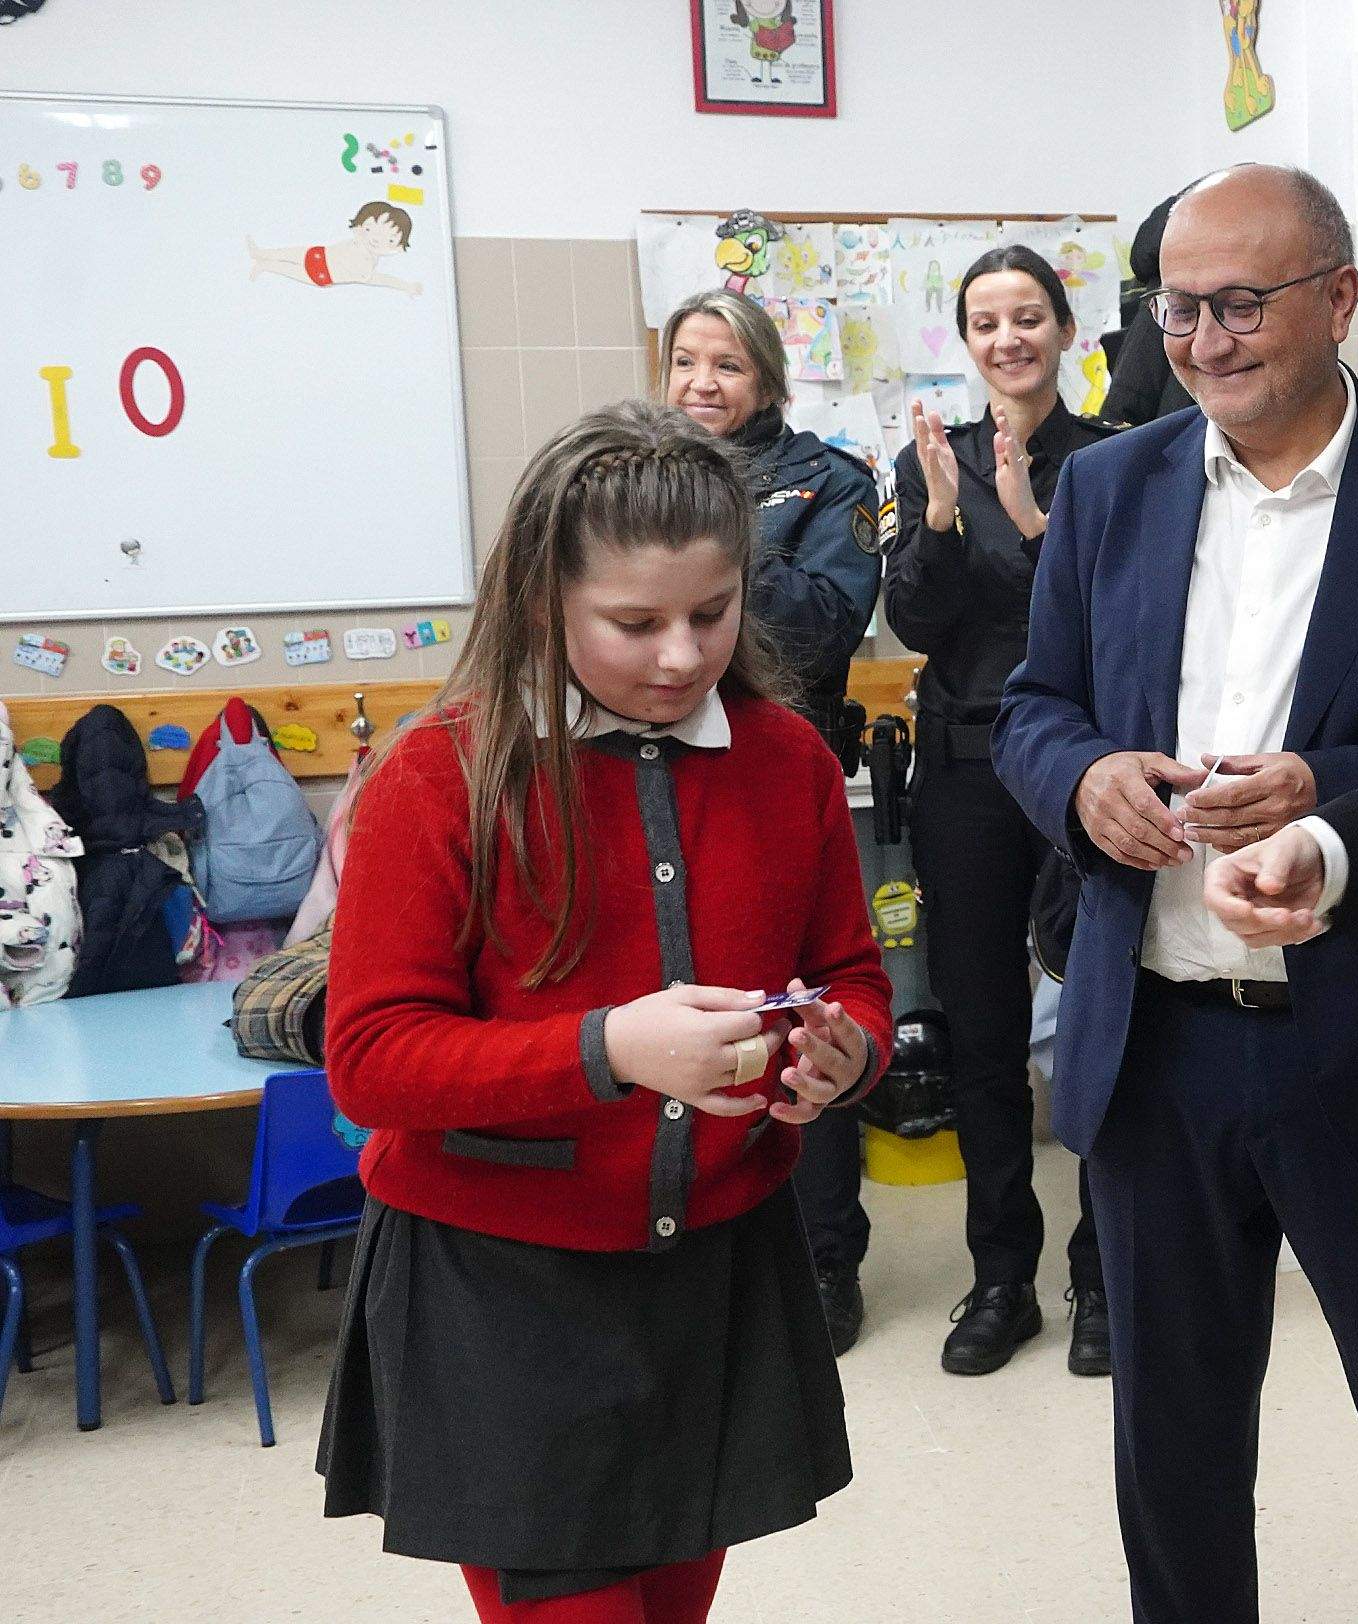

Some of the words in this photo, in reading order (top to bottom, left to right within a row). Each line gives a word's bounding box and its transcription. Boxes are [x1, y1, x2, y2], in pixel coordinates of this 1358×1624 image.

[19, 163, 41, 190] 6
[56, 161, 78, 189] 7
[102, 159, 124, 186] 8
[140, 164, 162, 191] 9
